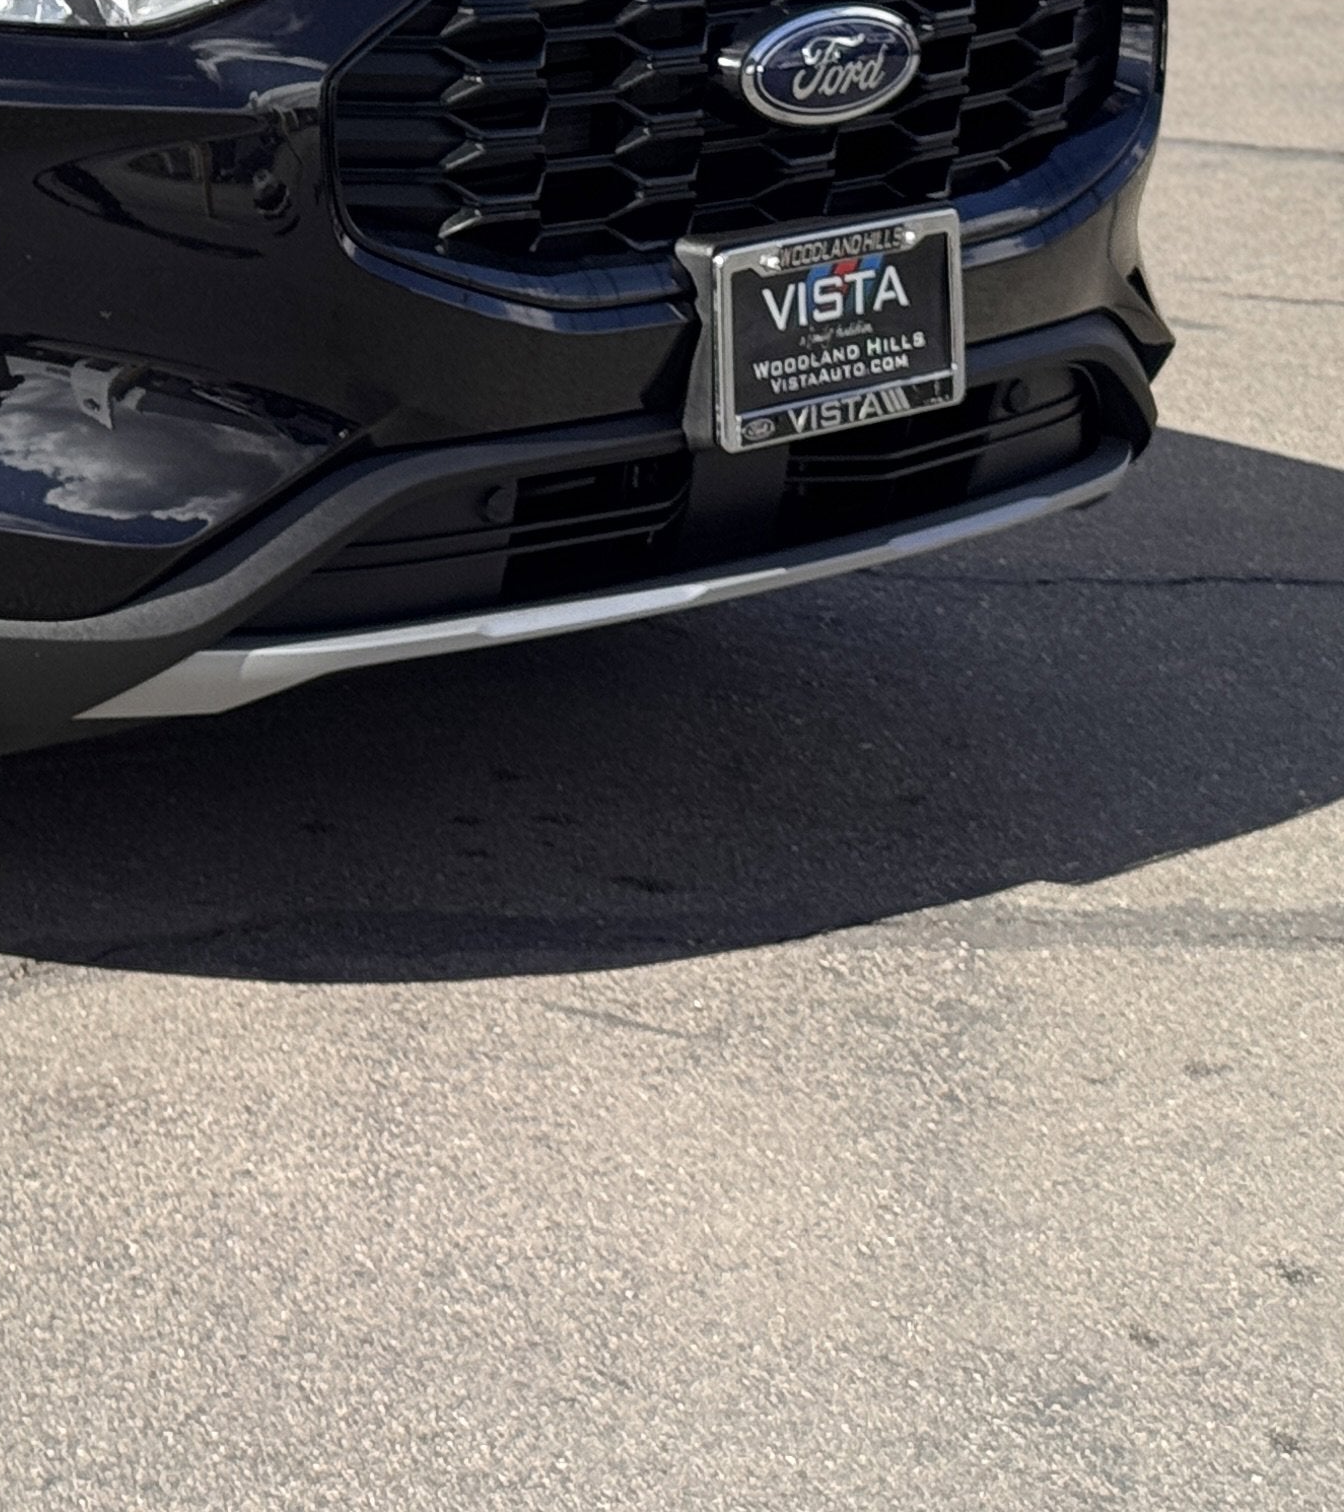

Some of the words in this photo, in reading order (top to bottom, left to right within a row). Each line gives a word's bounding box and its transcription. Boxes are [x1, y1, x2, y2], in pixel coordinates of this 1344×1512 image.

[792, 33, 889, 101] Ford
[863, 226, 904, 250] HILLS
[762, 265, 910, 332] VISTA
[752, 344, 861, 380] WOODLAND
[866, 330, 926, 356] HILLS
[787, 392, 885, 433] VISTA
